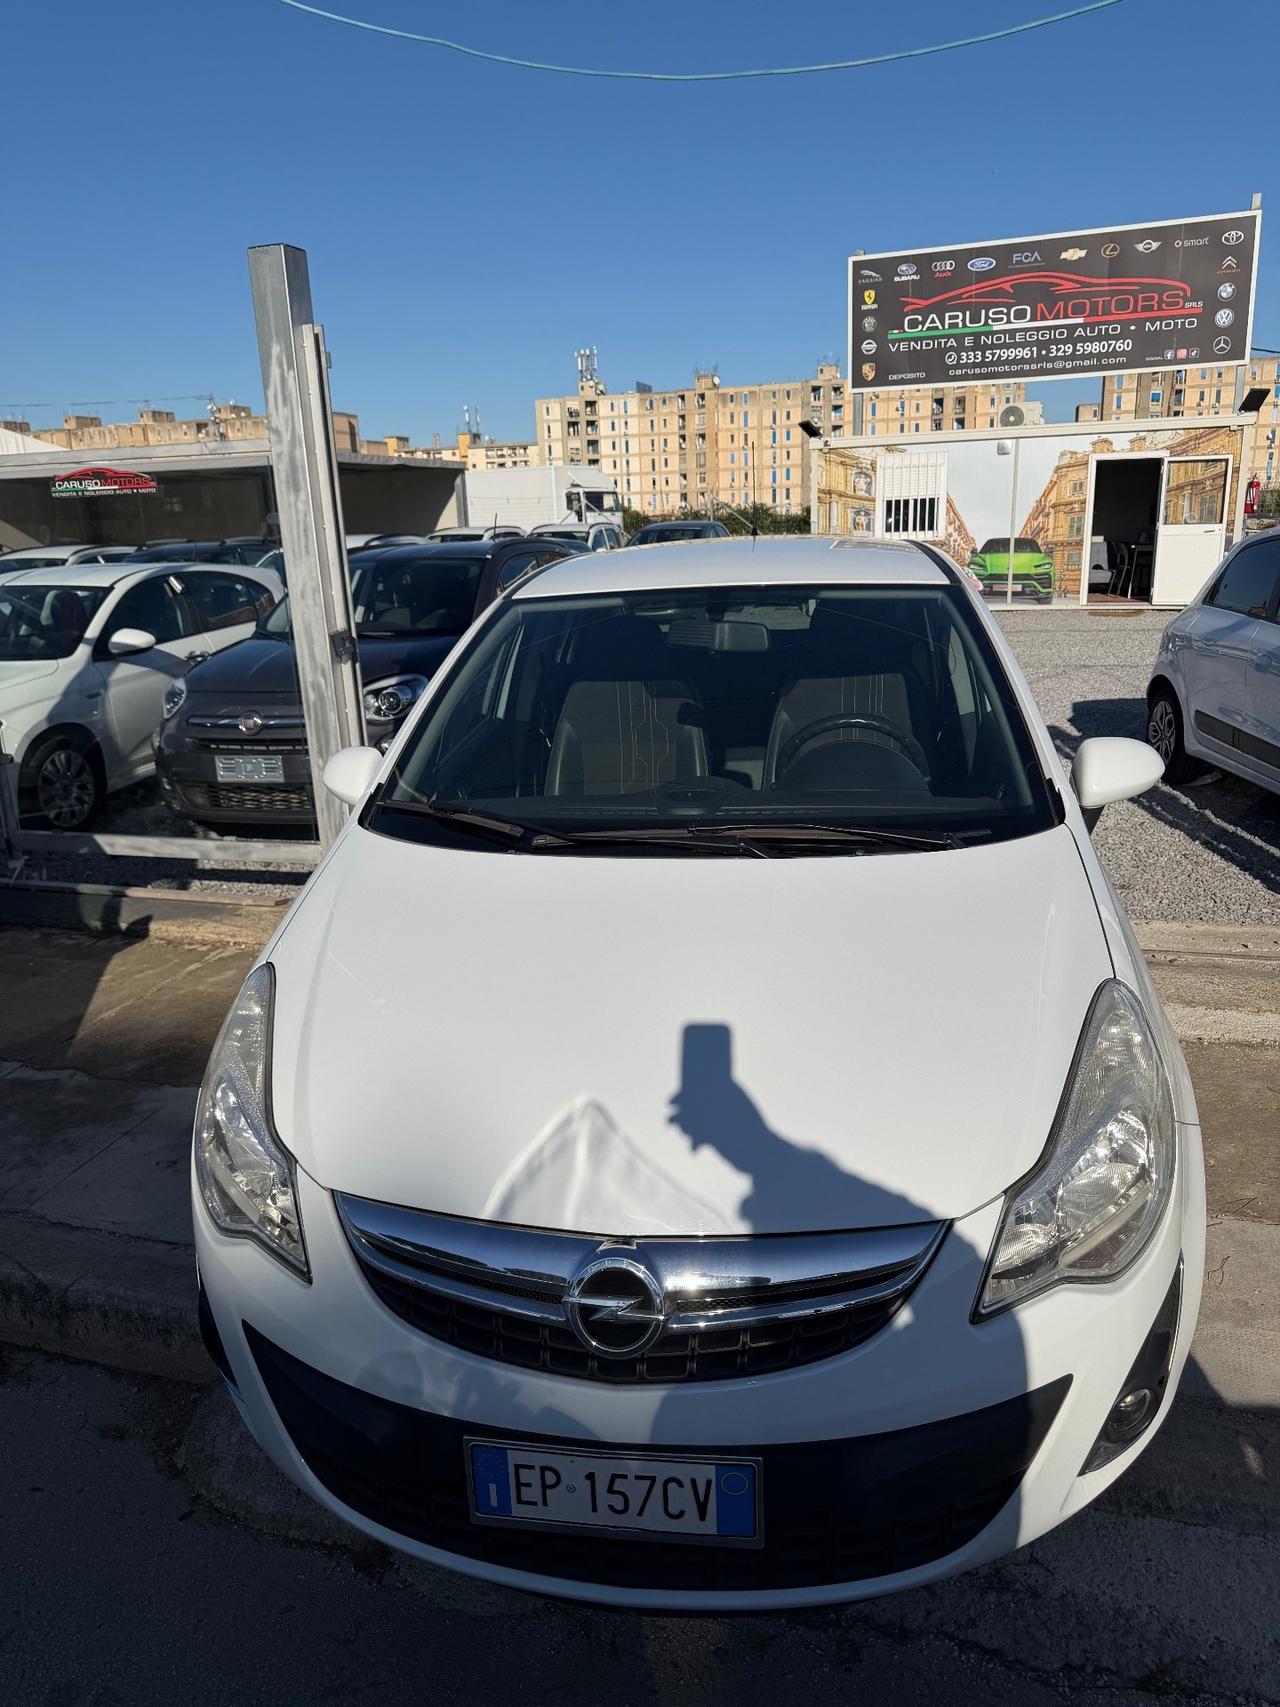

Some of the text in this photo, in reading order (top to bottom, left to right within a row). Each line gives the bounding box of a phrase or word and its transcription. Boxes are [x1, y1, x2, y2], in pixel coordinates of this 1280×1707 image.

[1013, 251, 1042, 263] FCA
[903, 305, 1031, 333] CARUSO
[1035, 290, 1184, 320] MOTORS
[888, 317, 1198, 352] VENDITA E NOLEGGIO AUTO MOTO
[959, 339, 1133, 364] 333 5799961 329 5980760
[888, 372, 926, 381] DEPOSITO
[55, 476, 152, 490] CARUSO MOTORS
[513, 1463, 562, 1507] EP
[584, 1471, 713, 1522] 157CV
